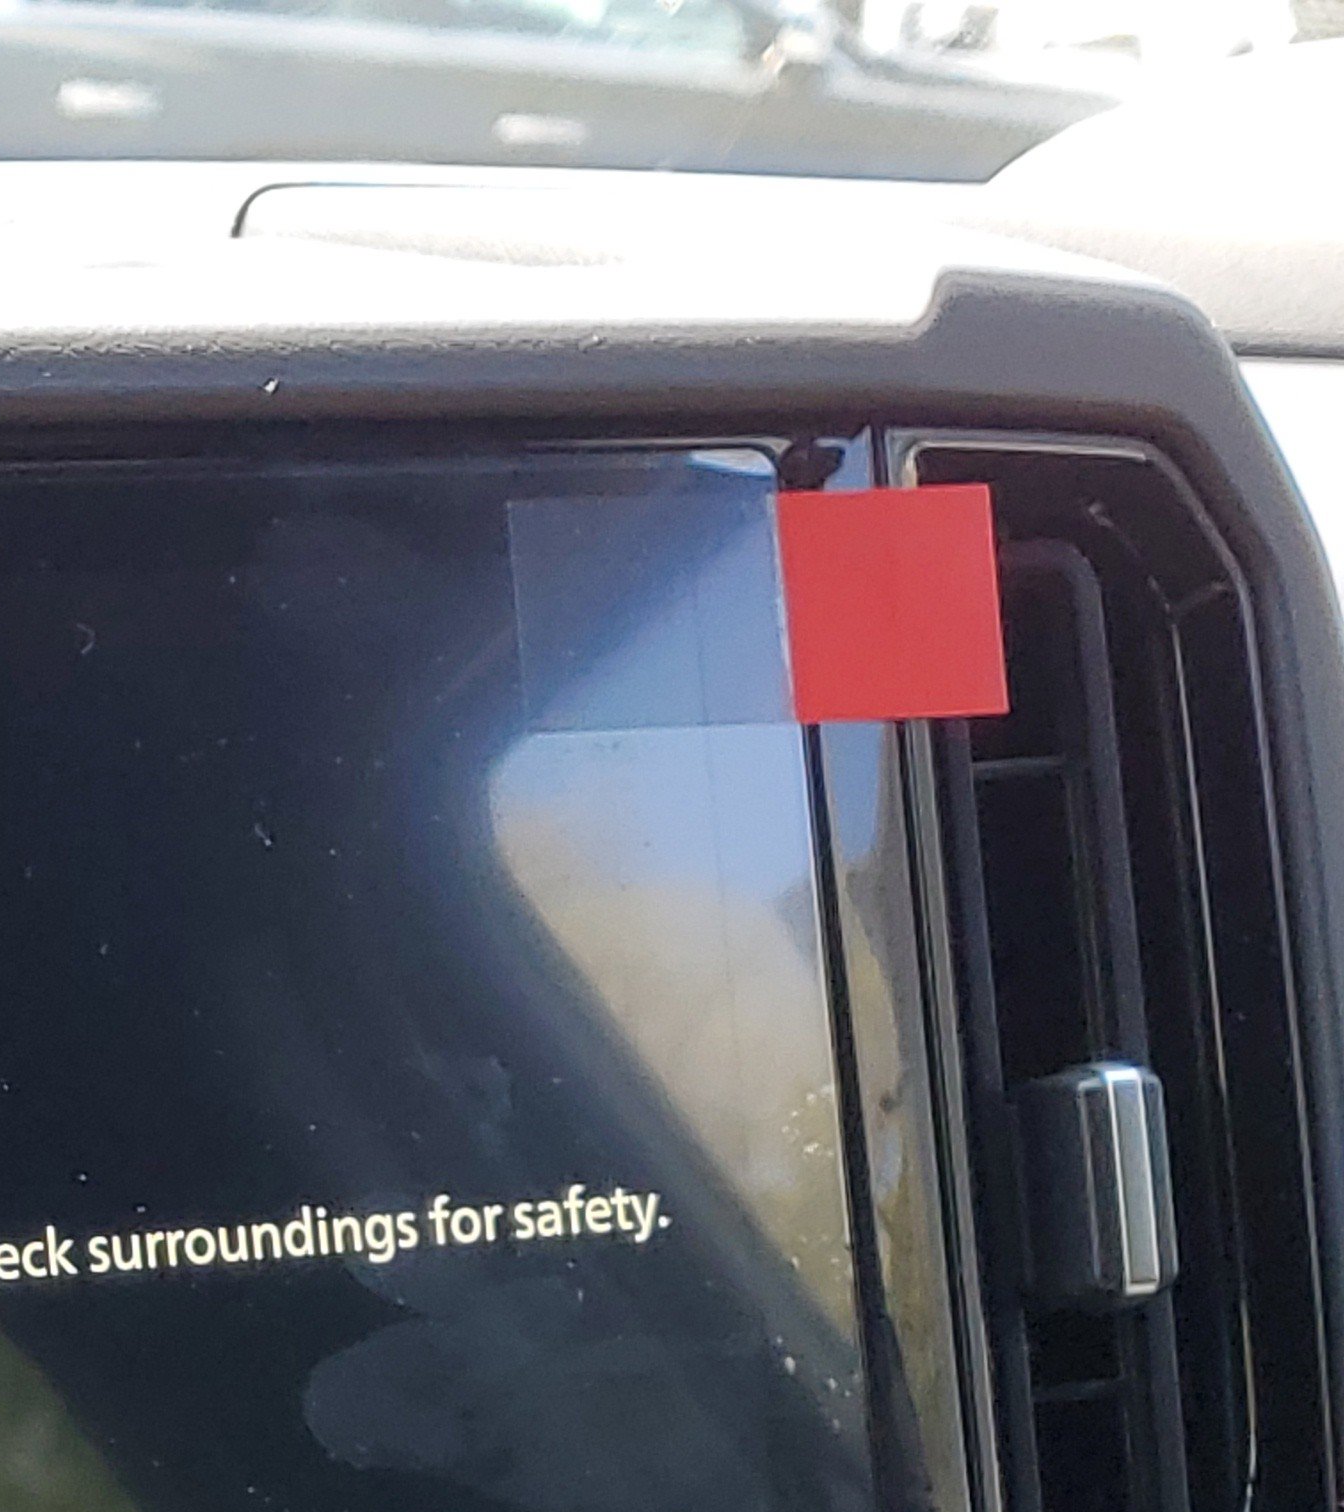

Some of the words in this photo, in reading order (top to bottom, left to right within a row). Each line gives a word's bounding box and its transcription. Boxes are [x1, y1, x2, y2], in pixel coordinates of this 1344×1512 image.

[88, 1206, 417, 1273] surroundings
[428, 1195, 502, 1246] for
[513, 1184, 671, 1244] safety.
